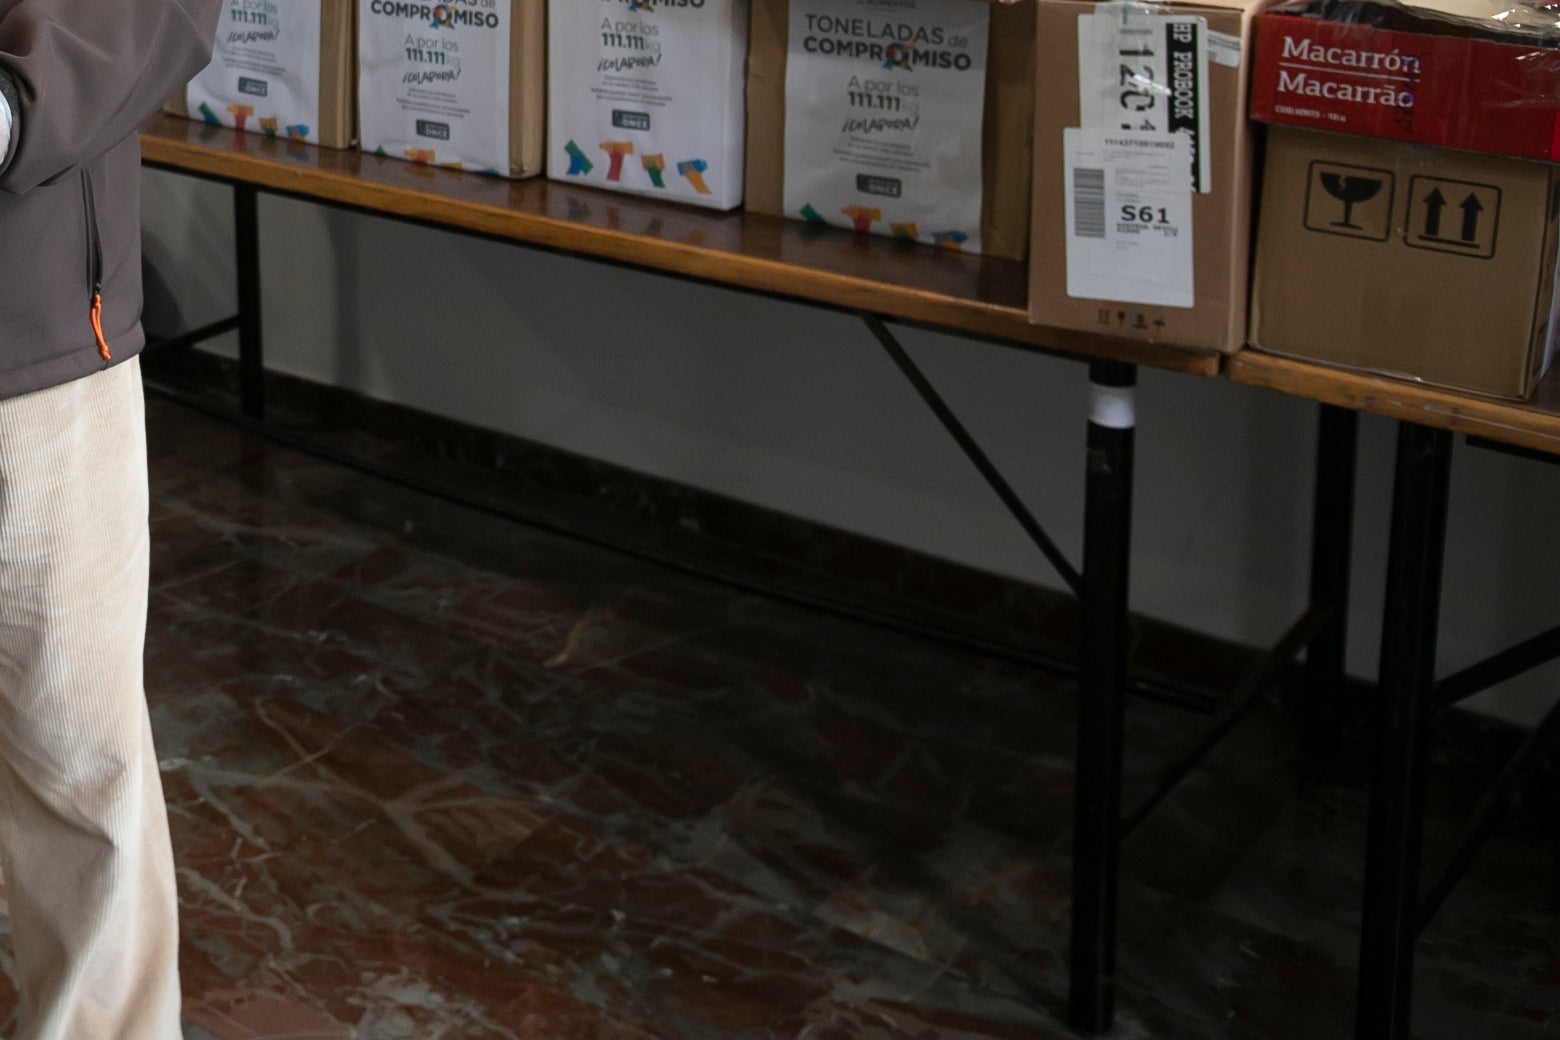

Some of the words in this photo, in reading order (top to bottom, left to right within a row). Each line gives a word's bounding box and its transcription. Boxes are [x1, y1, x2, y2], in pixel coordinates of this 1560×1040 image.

[371, 0, 499, 29] COMPROMISO
[601, 17, 612, 31] A
[615, 20, 637, 35] por
[640, 20, 659, 36] los
[601, 33, 645, 49] 111.111
[804, 14, 944, 44] TONELADAS
[1173, 22, 1192, 43] HP
[405, 33, 415, 45] A
[417, 36, 439, 50] por
[442, 35, 458, 52] los
[803, 36, 971, 70] COMPROMISO
[1282, 36, 1420, 73] Macarrón
[405, 48, 445, 65] 111.111
[1174, 51, 1195, 119] PROBOOK
[1277, 71, 1414, 108] Macarrão
[1121, 204, 1169, 224] S61
